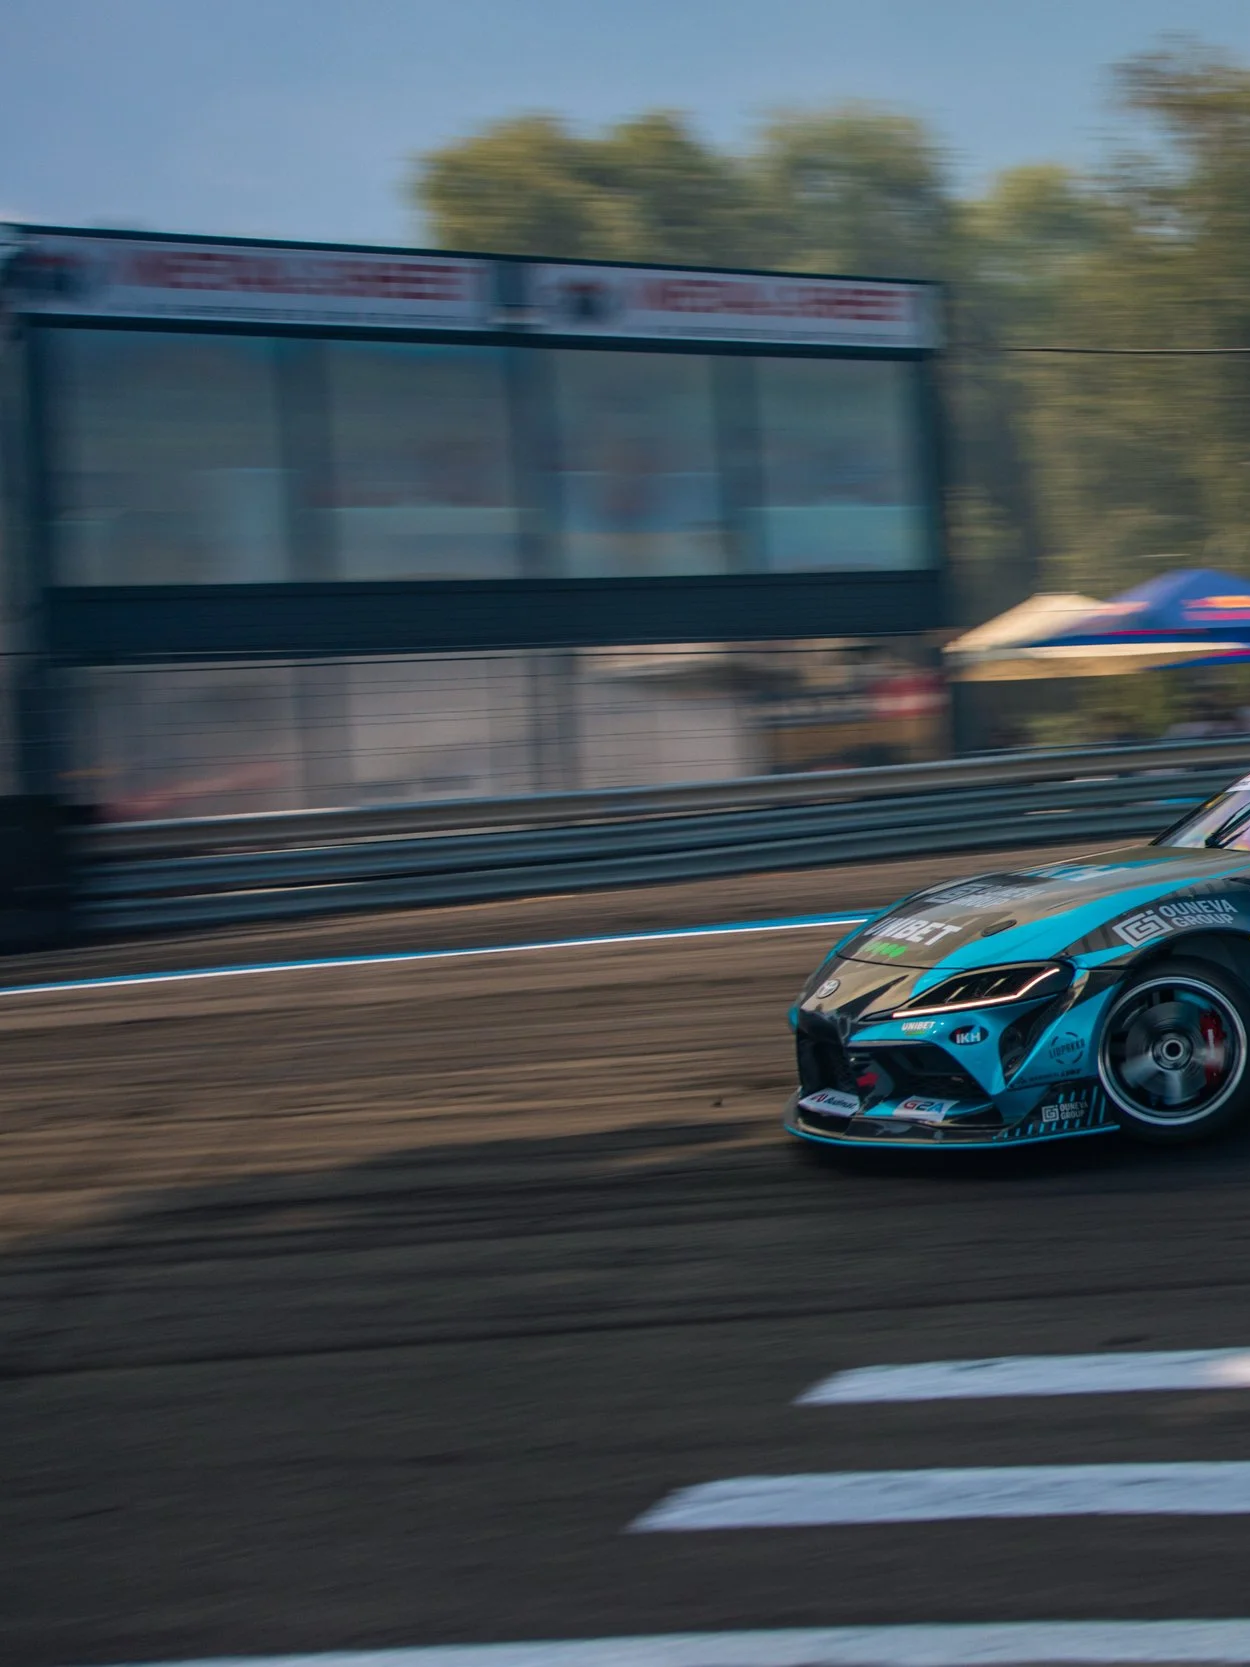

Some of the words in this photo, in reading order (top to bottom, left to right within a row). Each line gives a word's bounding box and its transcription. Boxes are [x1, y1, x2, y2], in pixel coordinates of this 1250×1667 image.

[1159, 899, 1239, 917] OUNEVA
[1171, 913, 1234, 927] GROUP
[863, 918, 963, 946] UNIBET
[902, 1021, 936, 1031] UNIBET
[903, 1100, 944, 1113] G2A
[1060, 1110, 1085, 1120] GROUP
